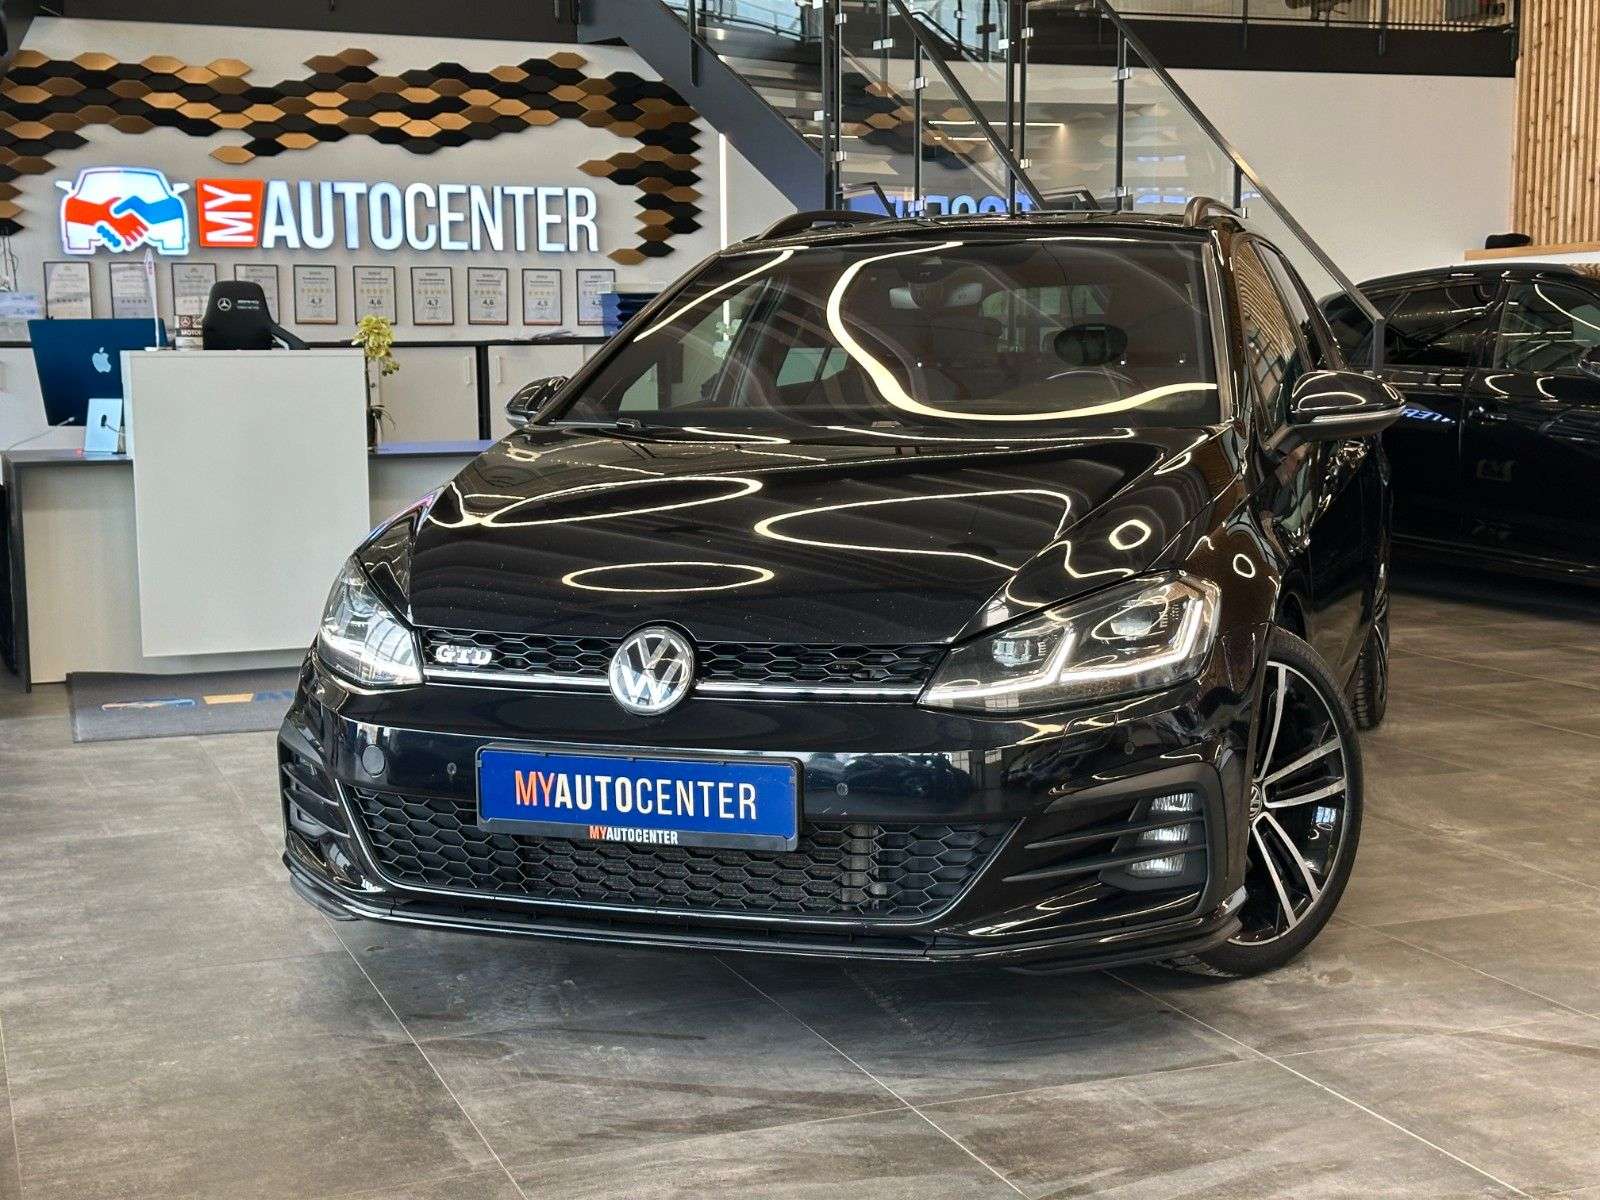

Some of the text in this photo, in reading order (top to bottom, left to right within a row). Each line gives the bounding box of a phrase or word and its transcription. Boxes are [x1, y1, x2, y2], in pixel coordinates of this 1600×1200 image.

[204, 180, 599, 252] MY AUTOCENTER
[435, 644, 493, 666] GTD
[514, 770, 758, 820] MYAUTOCENTER
[588, 825, 679, 846] MYAUTOCENTER
